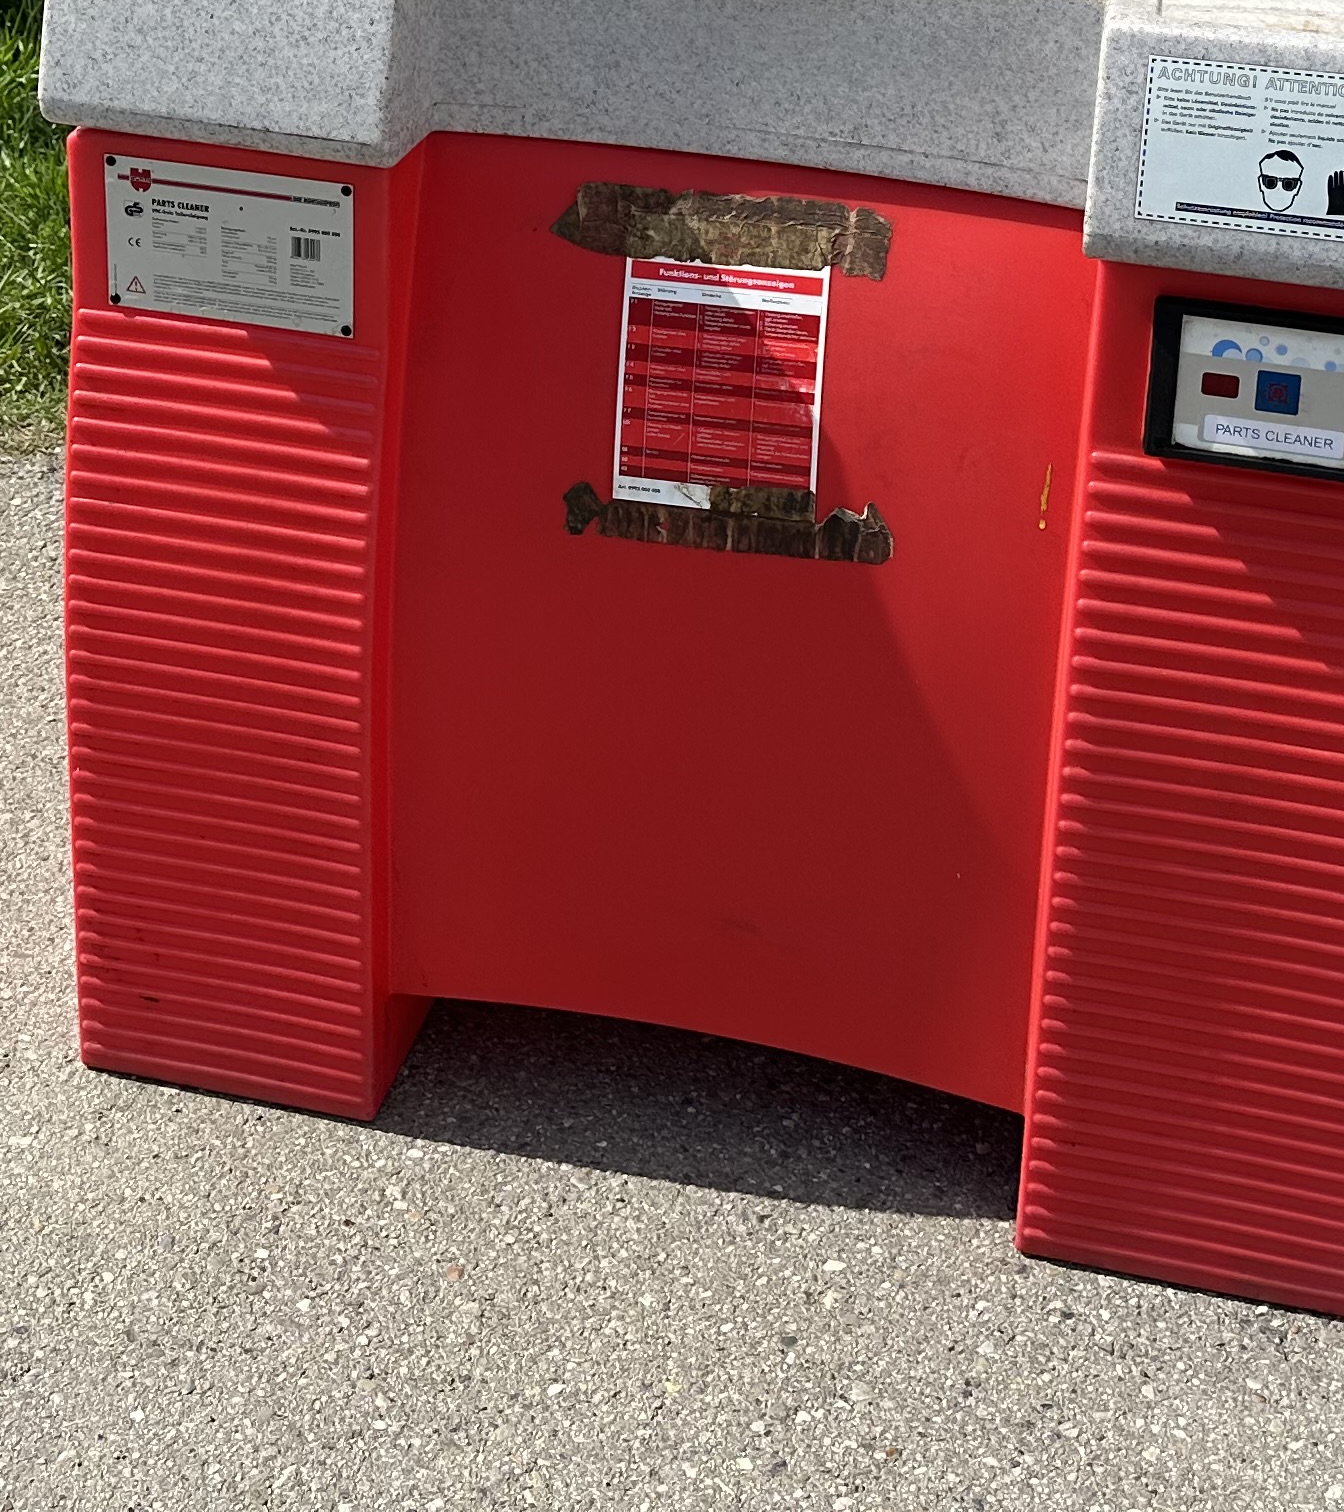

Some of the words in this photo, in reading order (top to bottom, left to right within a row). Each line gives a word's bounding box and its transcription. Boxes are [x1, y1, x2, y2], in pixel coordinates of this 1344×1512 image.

[1157, 65, 1257, 88] ACHTUNG!
[151, 198, 175, 208] PARTS
[177, 201, 209, 212] CLEANER
[659, 268, 701, 280] Funktions-
[703, 273, 720, 282] und
[720, 273, 795, 289] Störungsanzeigen
[1215, 423, 1261, 440] PARTS
[1265, 430, 1334, 450] CLEANER
